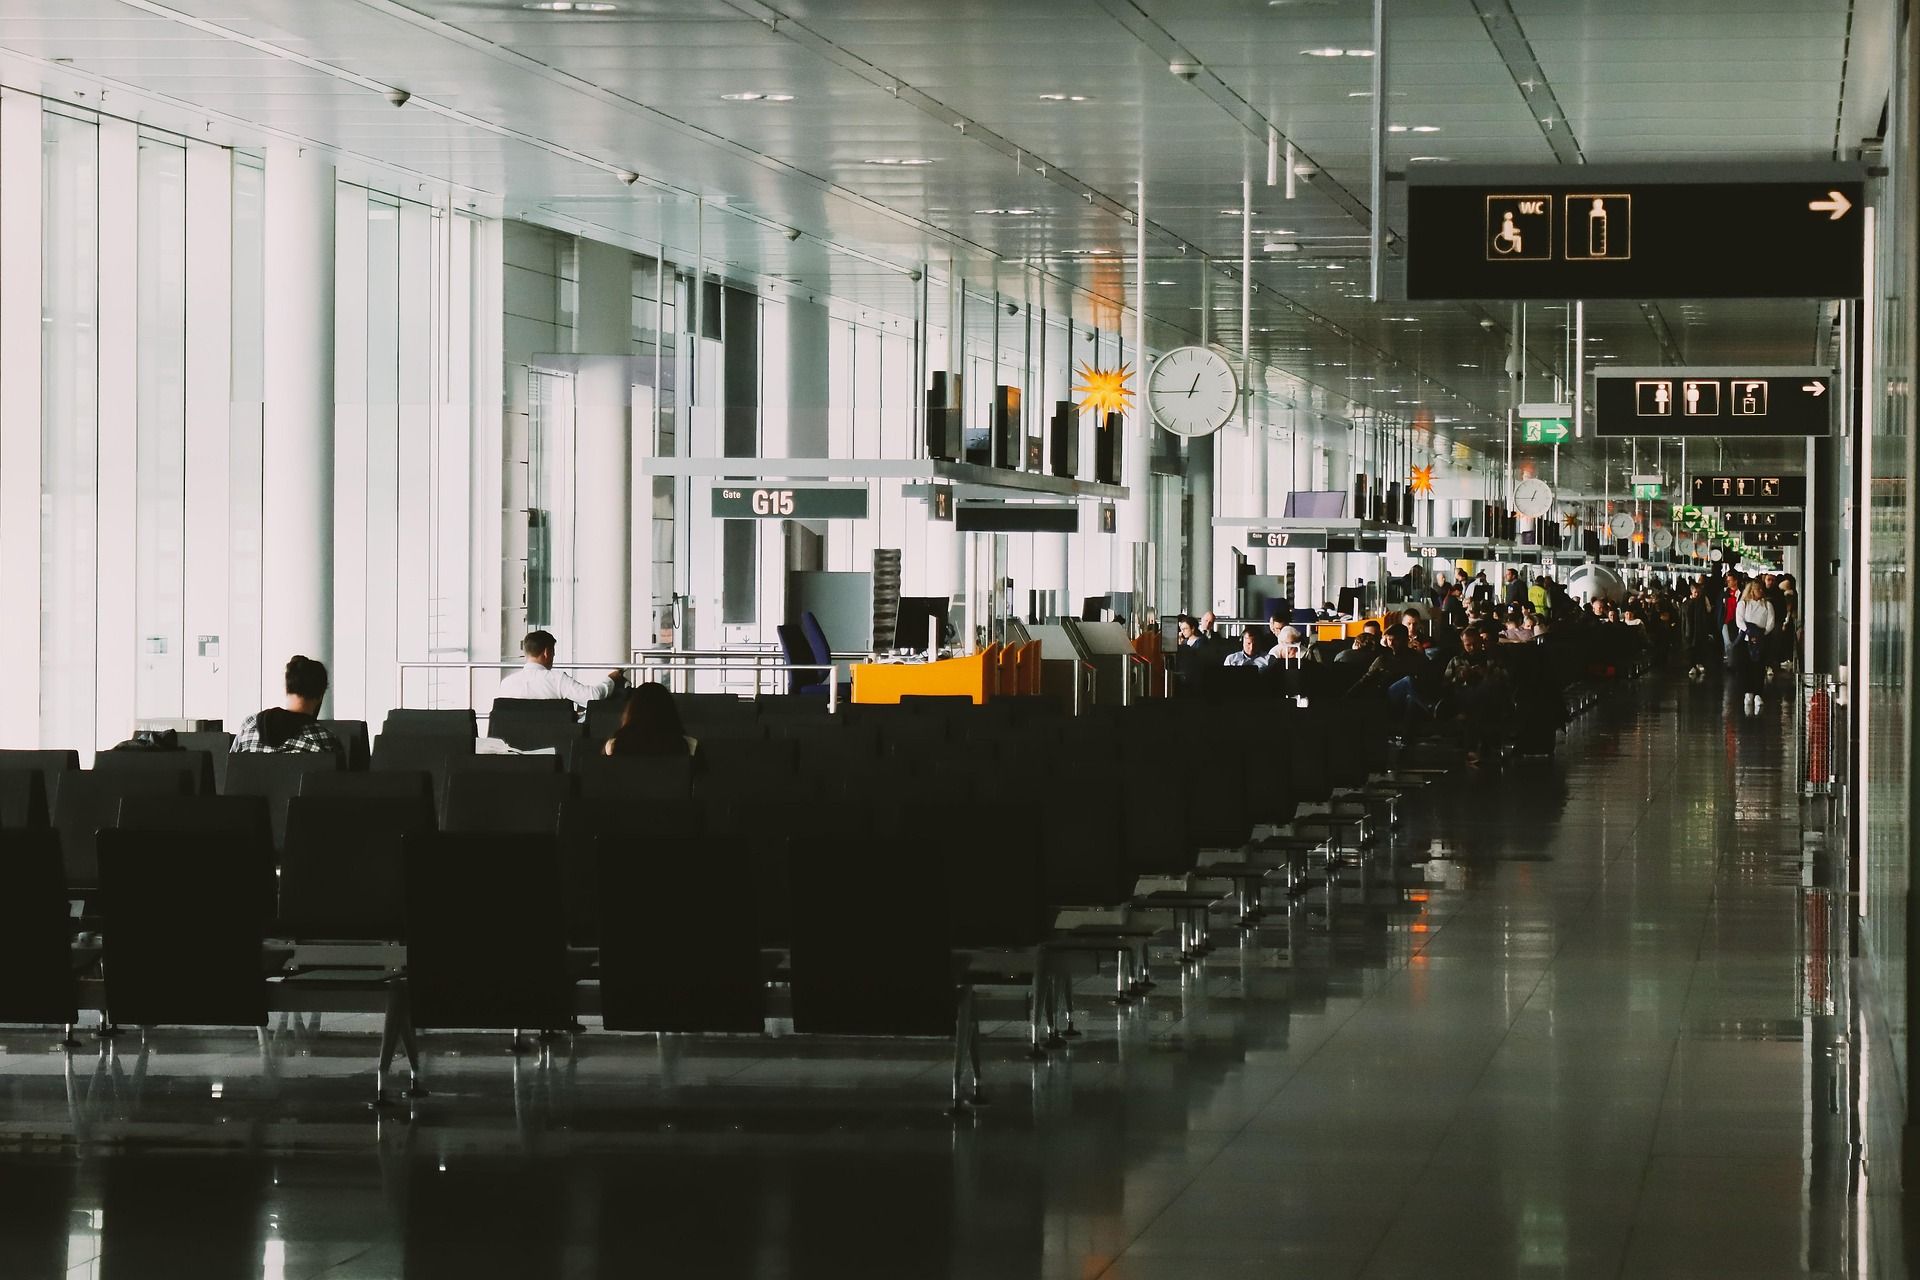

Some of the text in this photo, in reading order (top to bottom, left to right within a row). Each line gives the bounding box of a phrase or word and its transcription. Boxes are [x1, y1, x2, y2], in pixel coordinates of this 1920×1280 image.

[1518, 201, 1544, 214] WC
[722, 489, 794, 515] Gate G15
[1267, 533, 1289, 547] G17
[1420, 547, 1437, 557] G19
